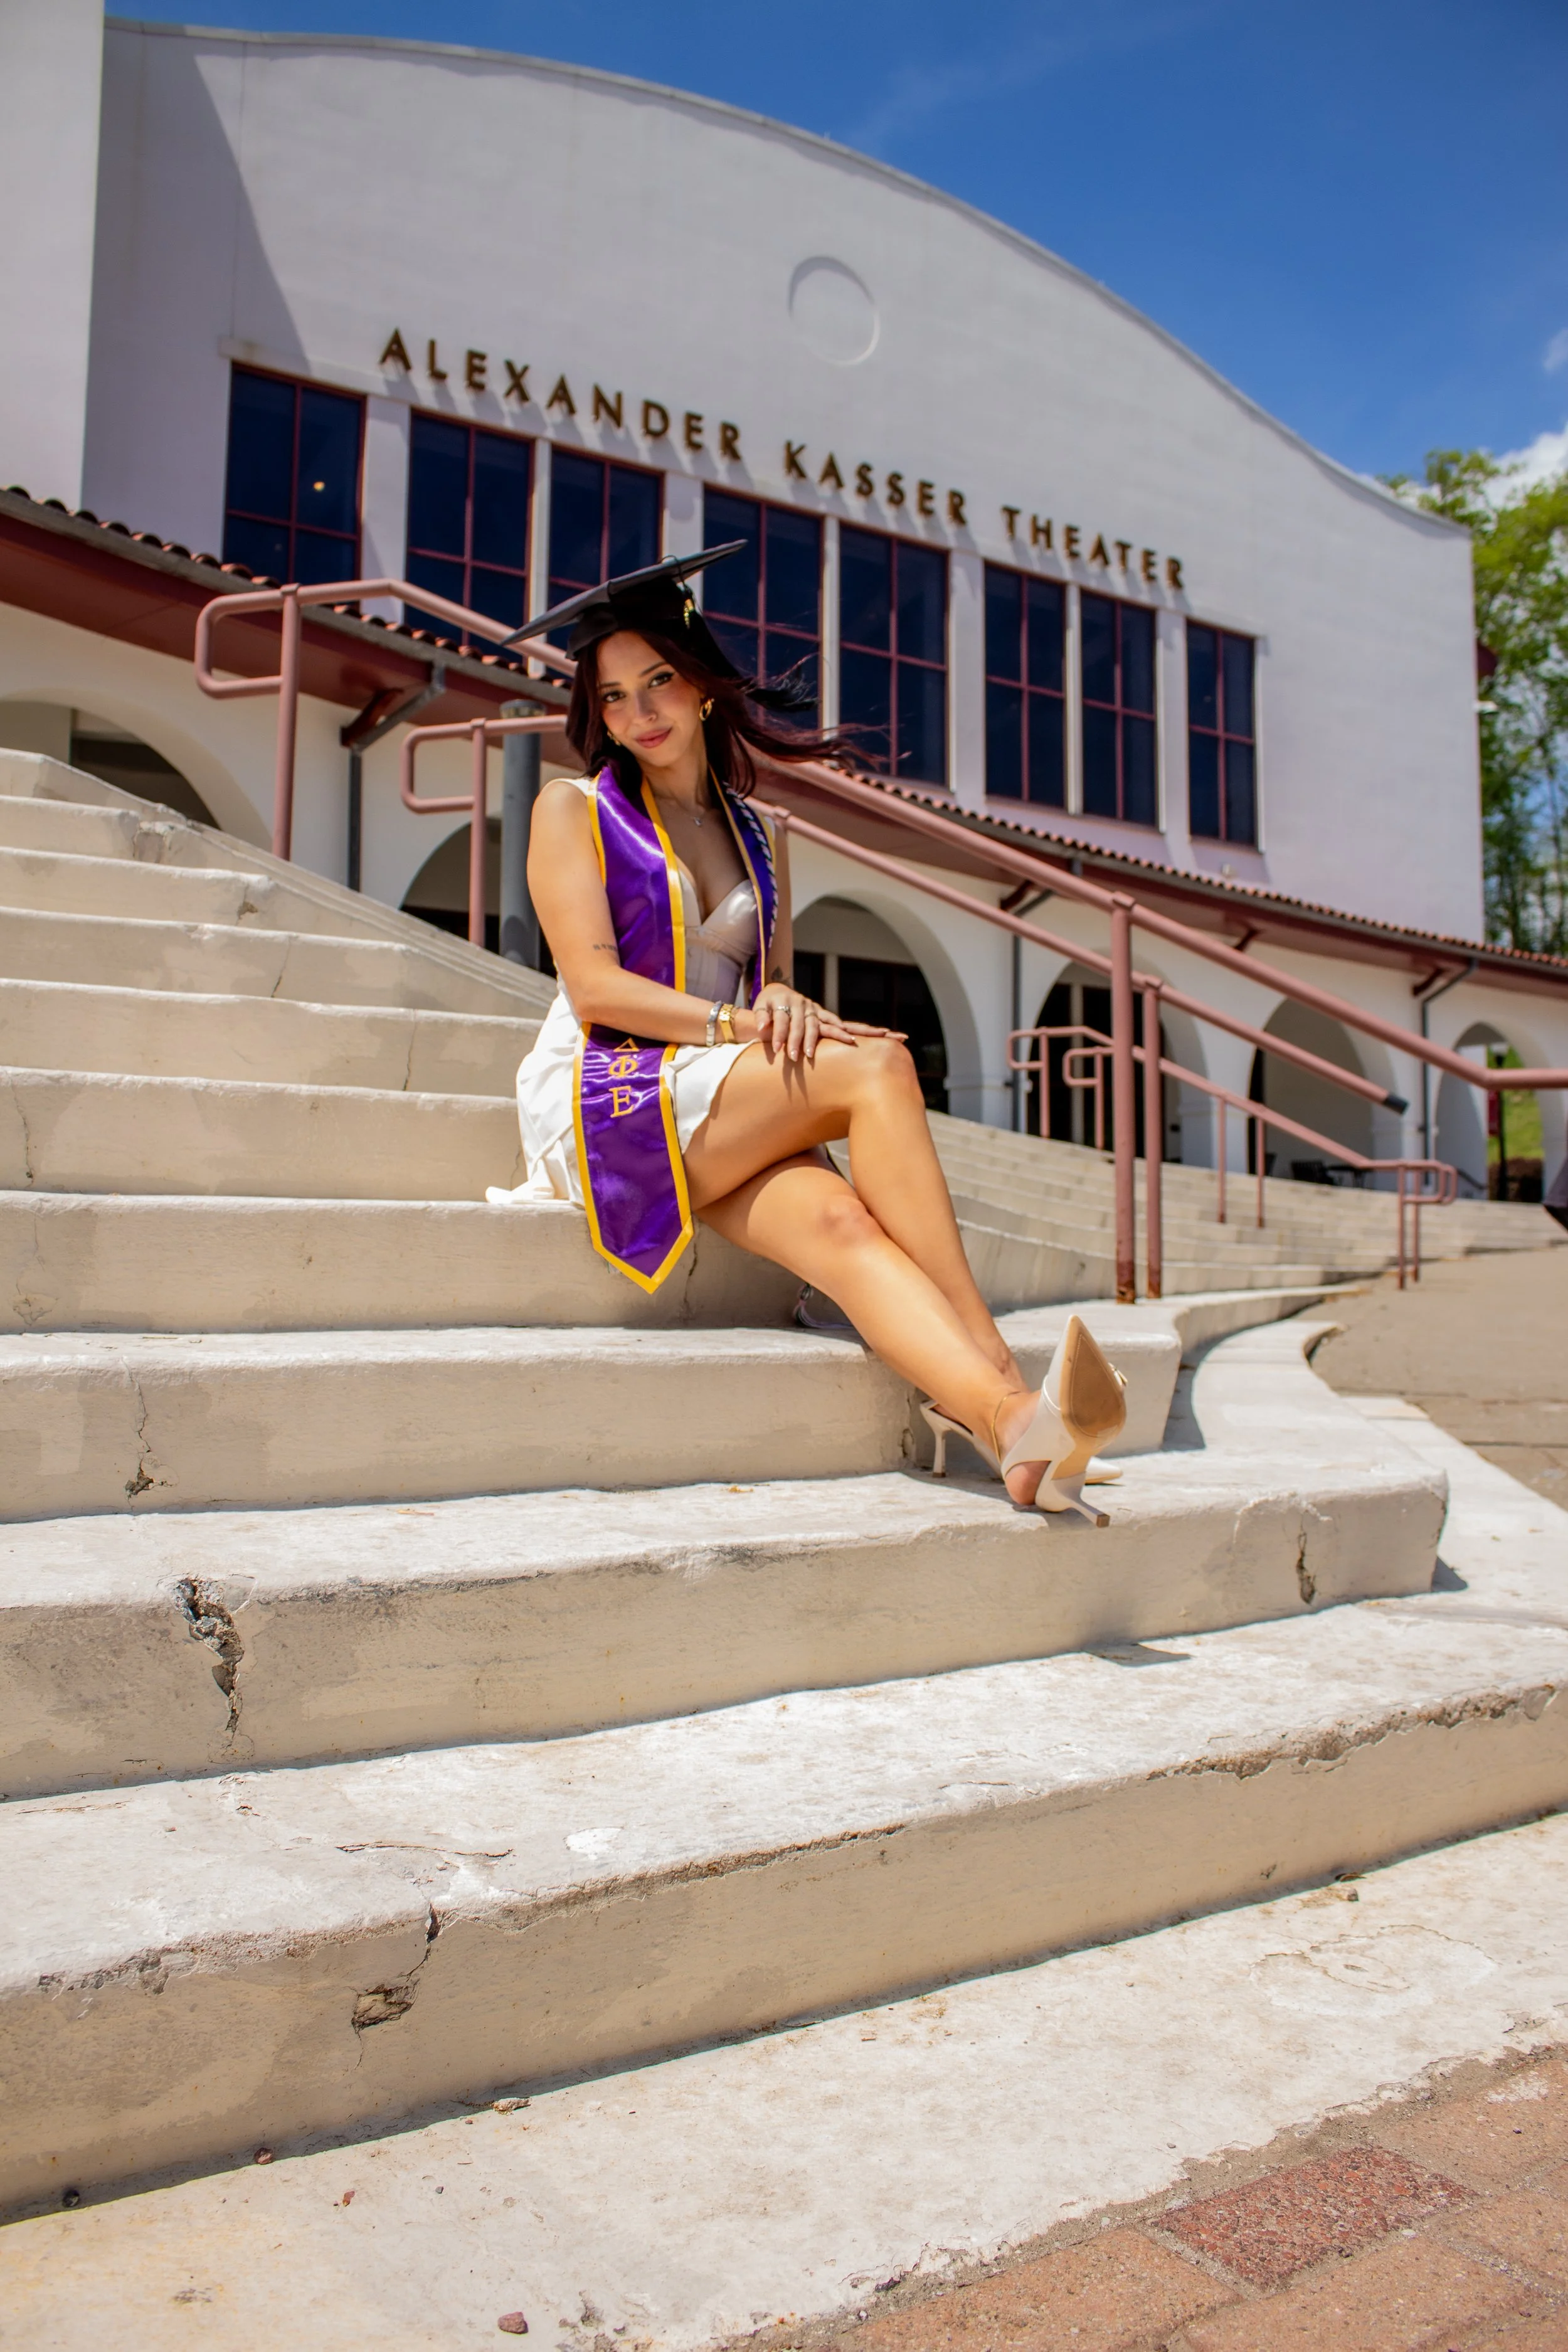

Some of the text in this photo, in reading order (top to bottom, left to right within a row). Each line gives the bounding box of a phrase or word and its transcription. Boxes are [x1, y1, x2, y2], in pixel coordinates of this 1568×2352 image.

[379, 328, 1184, 591] ALEXANDER KASSER THEATER
